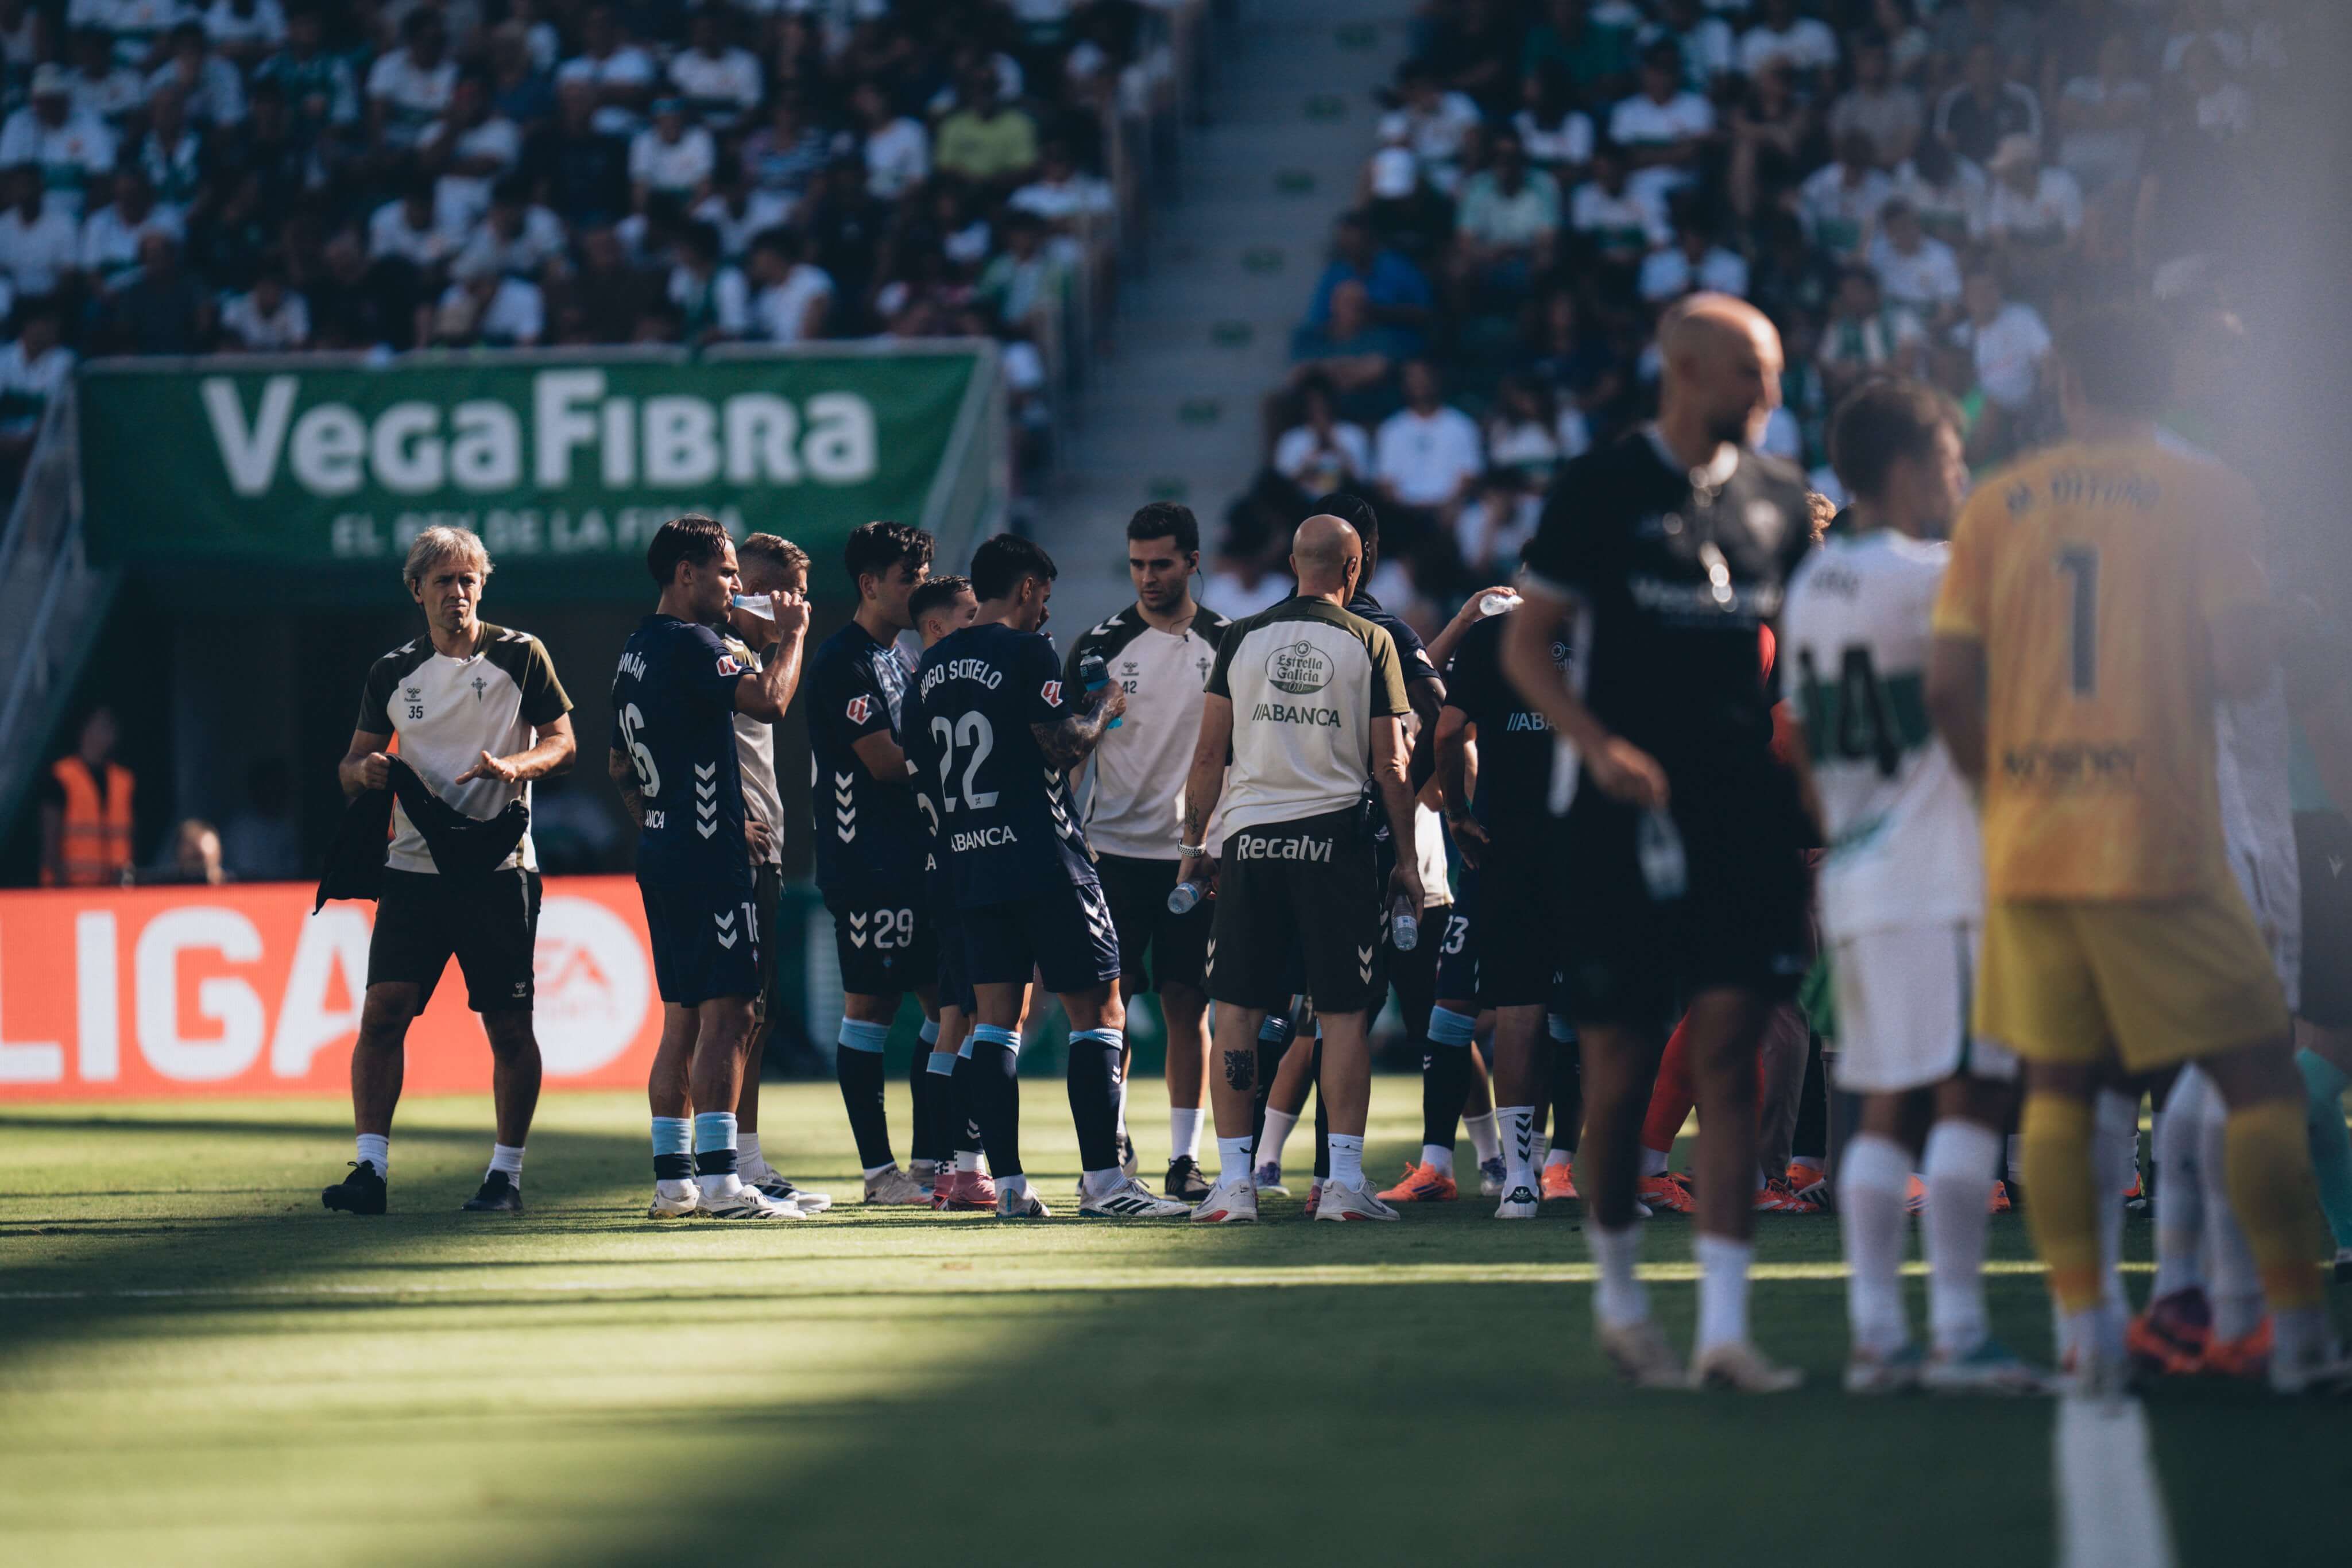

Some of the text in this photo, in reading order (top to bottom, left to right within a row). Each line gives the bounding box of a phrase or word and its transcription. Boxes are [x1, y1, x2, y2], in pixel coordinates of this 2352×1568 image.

[2055, 541, 2099, 696] 1
[1277, 655, 1322, 670] Estrella
[1277, 666, 1319, 683] Galicia
[920, 659, 1003, 704] HUGO SOTELO
[1123, 680, 1137, 694] 42
[408, 706, 423, 719] 35
[1797, 642, 1901, 780] 14
[930, 710, 999, 812] 22
[1237, 834, 1333, 862] Recalvi
[874, 908, 913, 948] 29
